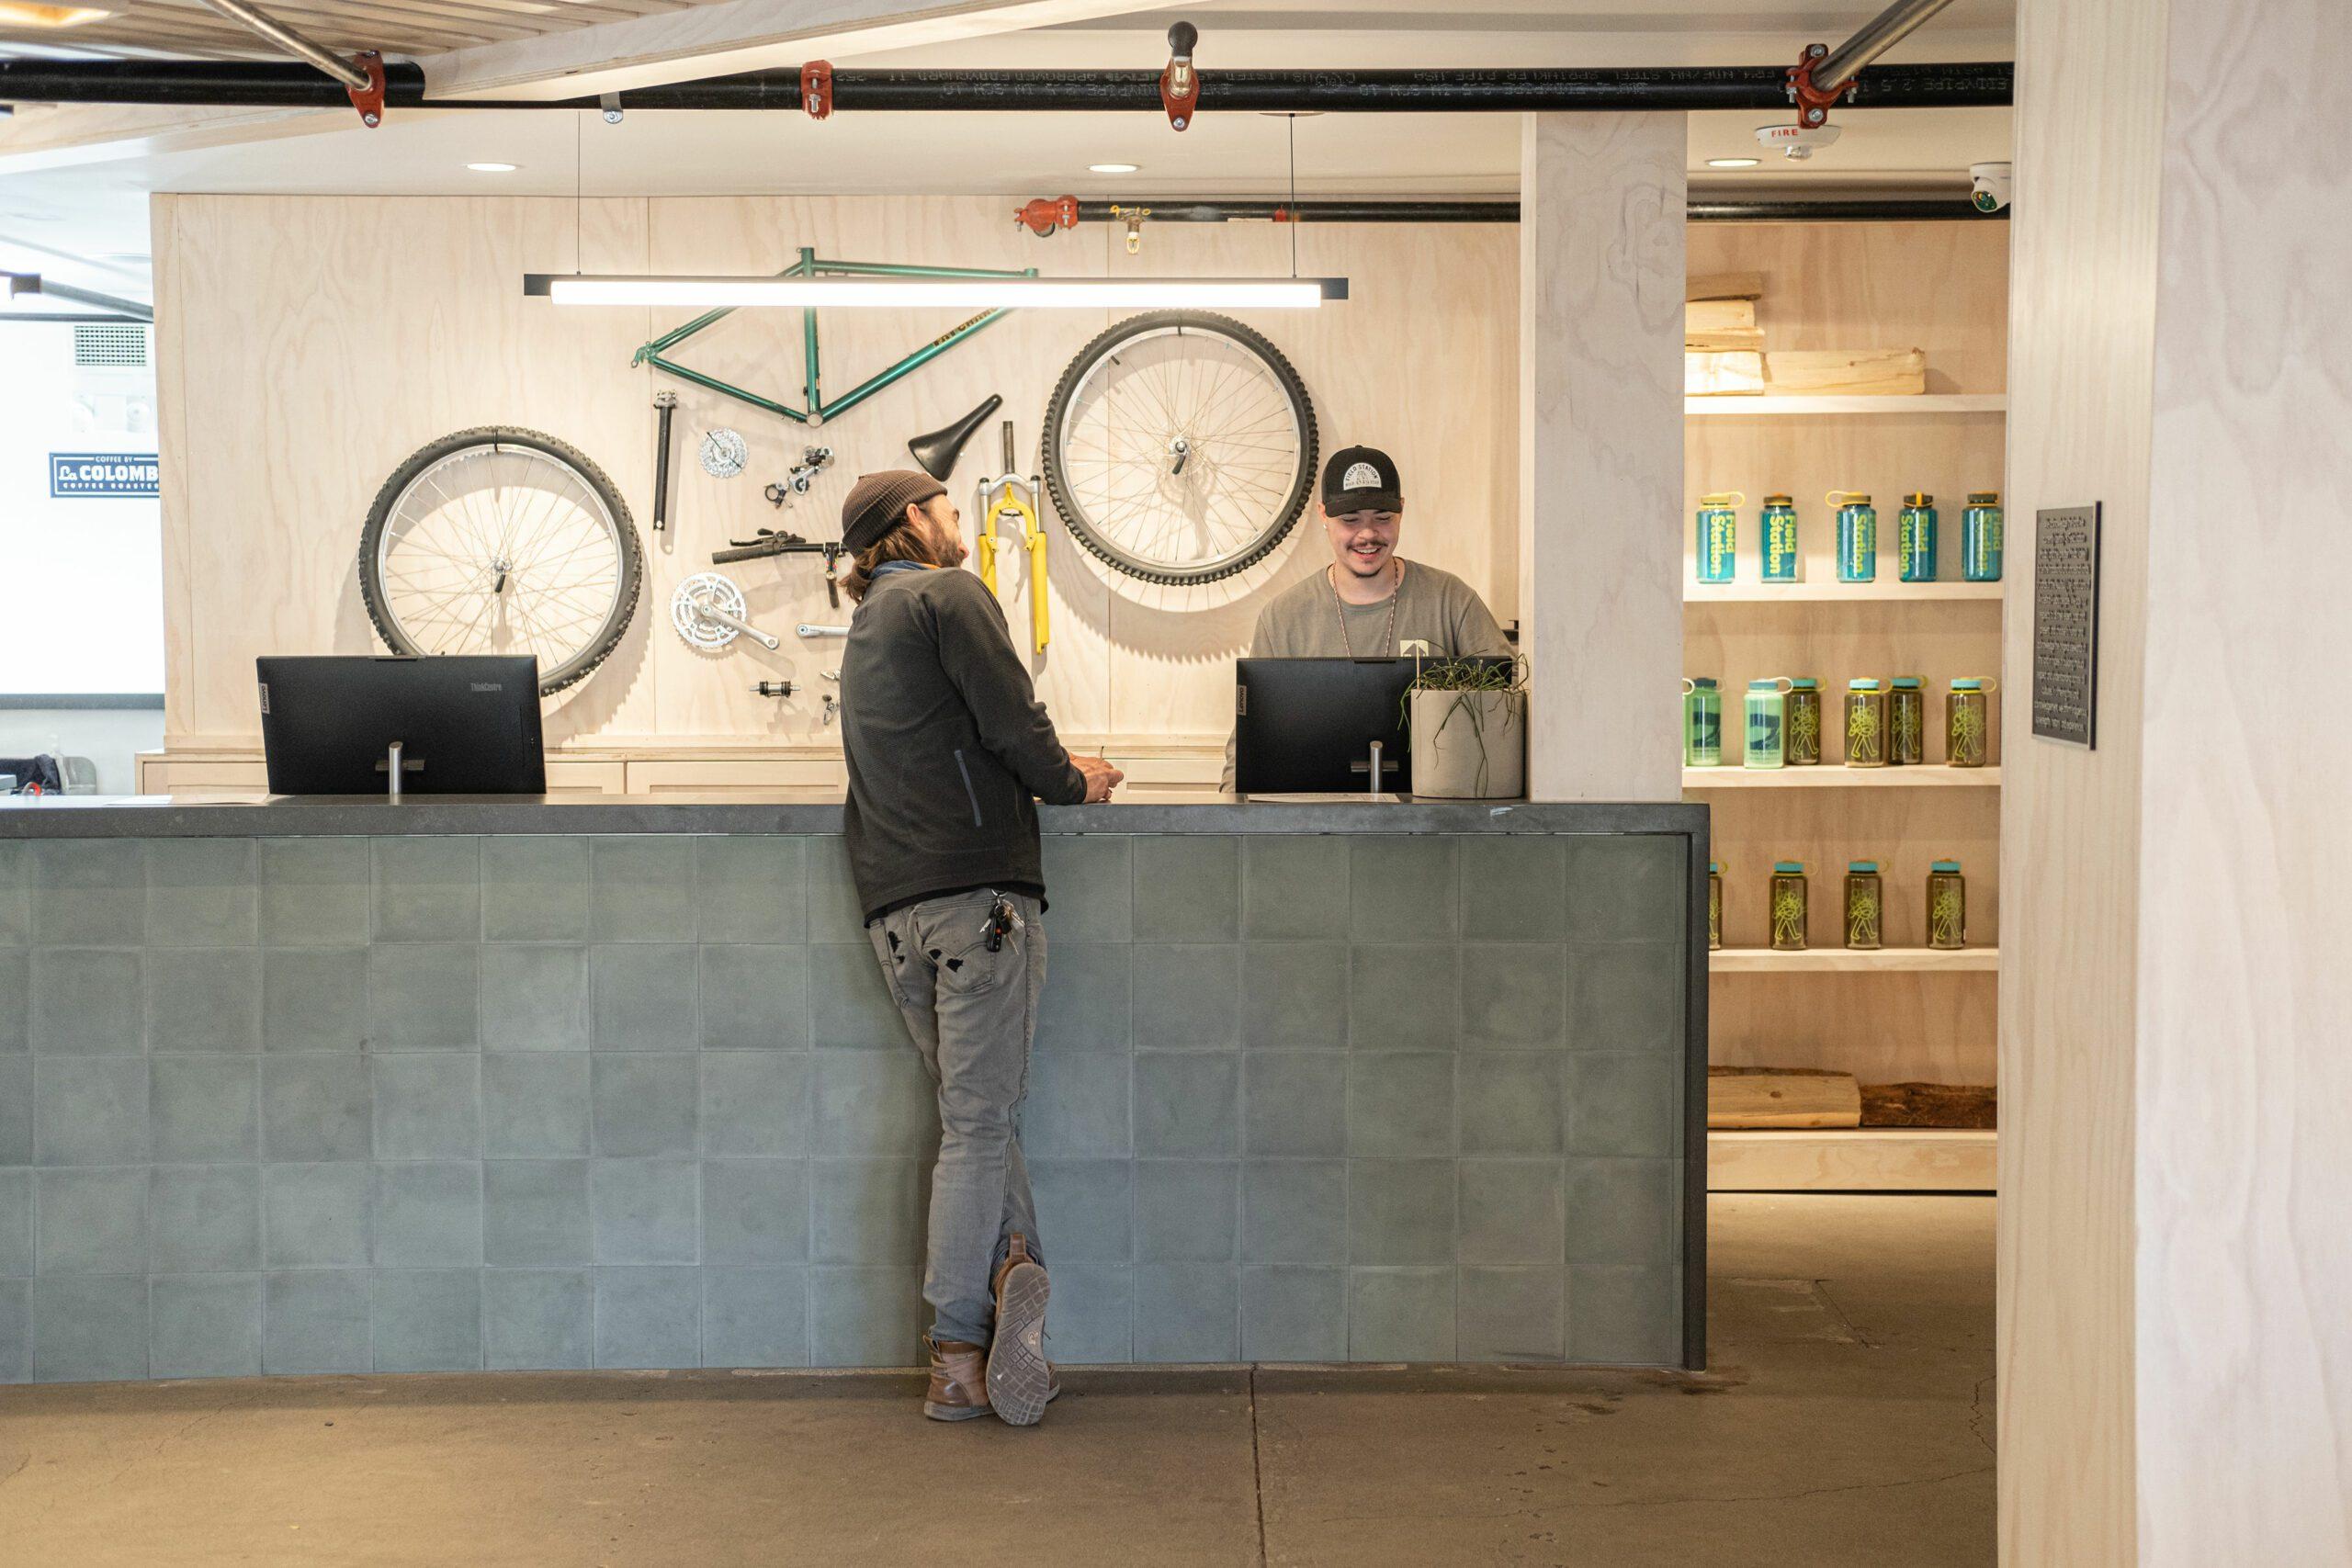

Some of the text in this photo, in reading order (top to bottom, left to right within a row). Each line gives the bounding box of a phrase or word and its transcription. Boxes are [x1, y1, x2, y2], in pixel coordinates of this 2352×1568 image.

[1771, 129, 1799, 138] FIRE
[59, 465, 77, 480] La
[1346, 464, 1379, 481] FIELD STATION
[1711, 514, 1726, 574] Station
[1725, 514, 1735, 553] Field
[1770, 514, 1785, 574] Station
[1784, 514, 1795, 553] Field
[1855, 513, 1868, 573] Station
[1900, 514, 1913, 573] Station
[1917, 513, 1928, 552] Field
[1993, 513, 2003, 551] Field
